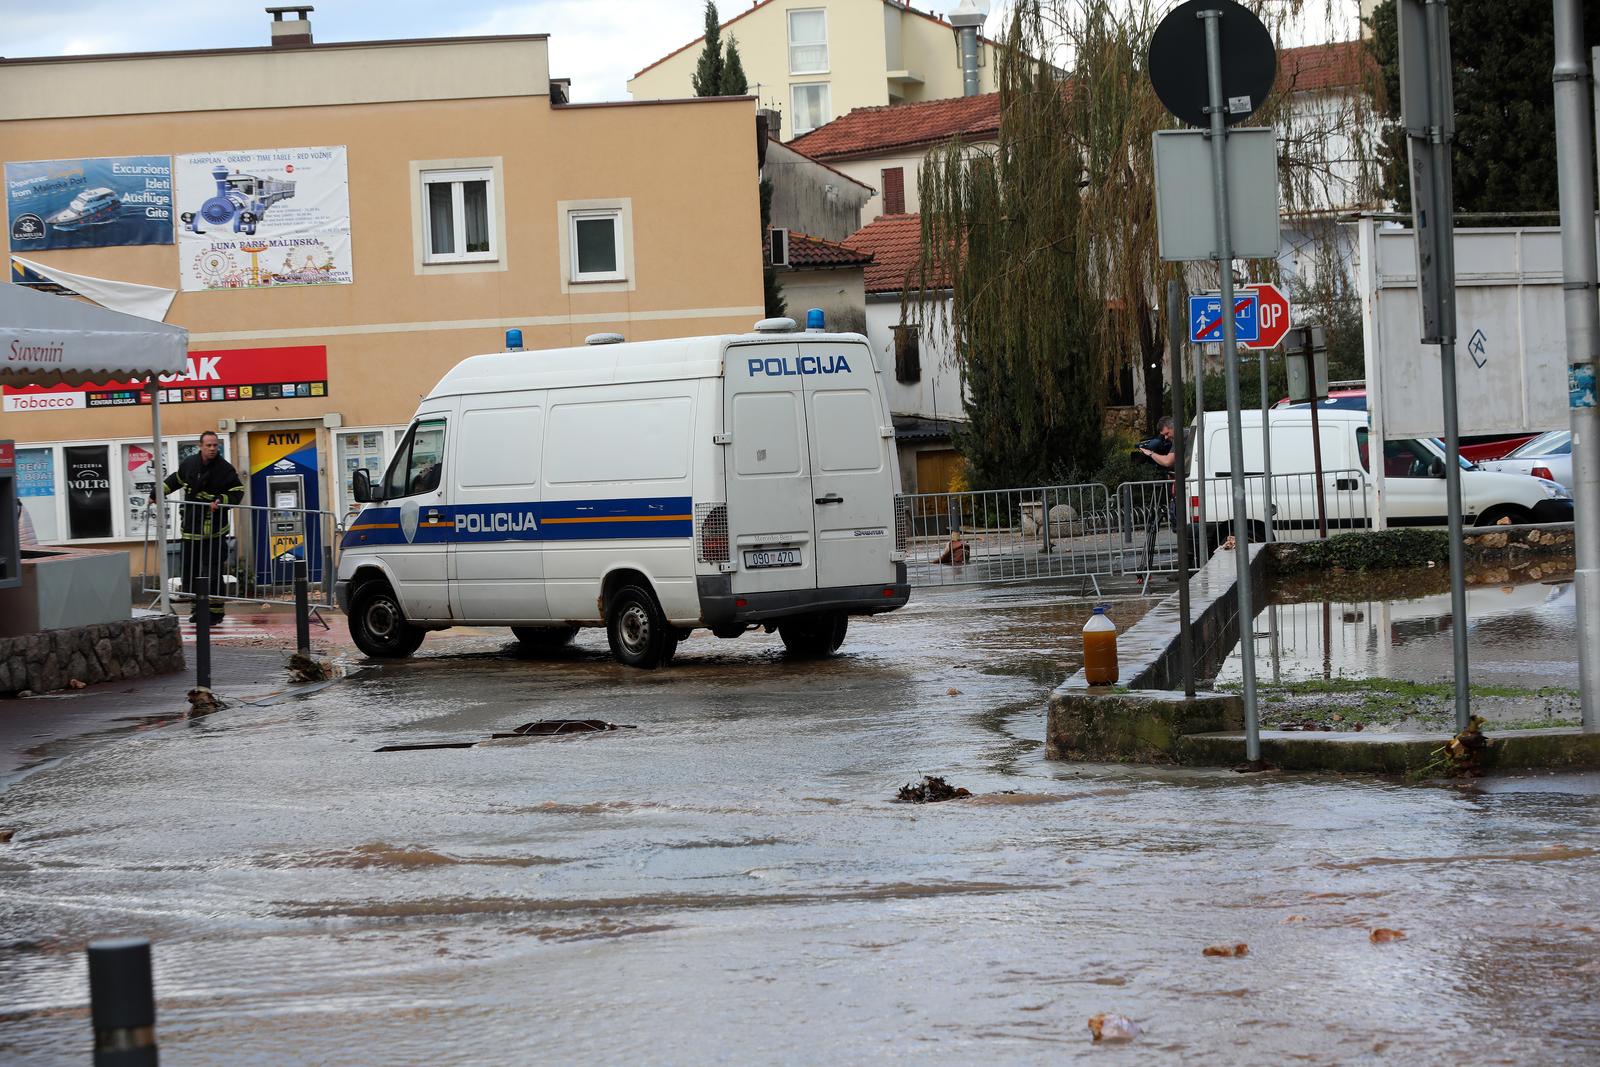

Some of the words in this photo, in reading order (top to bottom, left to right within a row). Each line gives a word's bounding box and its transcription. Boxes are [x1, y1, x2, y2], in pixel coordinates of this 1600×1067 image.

[256, 154, 272, 162] TIME
[273, 153, 291, 161] TABLE
[112, 162, 169, 175] Excursions
[12, 188, 31, 198] from
[69, 176, 87, 186] Port
[145, 178, 169, 189] Izleti
[122, 192, 169, 205] Ausflüge
[211, 240, 237, 251] LUNA
[239, 240, 265, 250] PARK
[269, 238, 320, 247] MALINSKA
[1260, 303, 1282, 329] OP
[8, 339, 64, 362] Suveniri
[747, 355, 852, 377] POLICIJA
[12, 396, 74, 409] Tobacco
[267, 432, 300, 446] ATM
[18, 462, 48, 471] RENT
[24, 472, 53, 481] BOAT
[454, 510, 537, 533] POLICIJA
[276, 537, 298, 546] ATM
[752, 552, 770, 565] 090
[777, 551, 794, 563] 470
